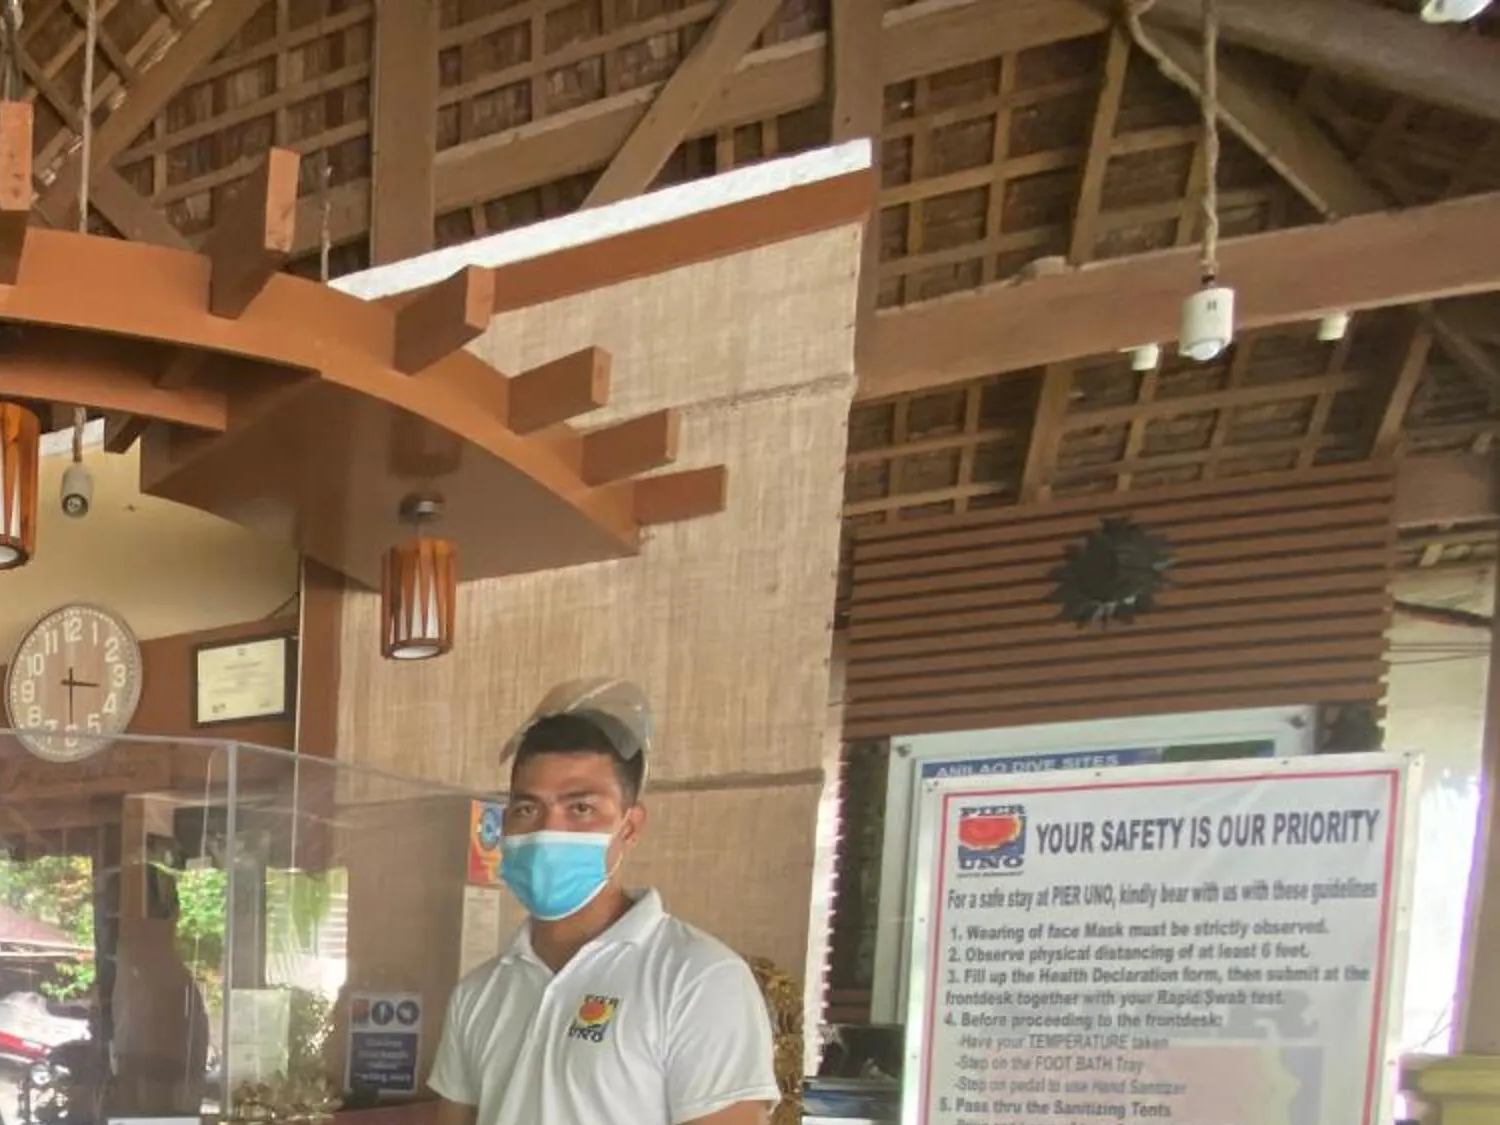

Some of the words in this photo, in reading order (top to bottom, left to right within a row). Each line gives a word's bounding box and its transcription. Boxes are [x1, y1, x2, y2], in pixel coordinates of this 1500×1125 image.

[63, 616, 83, 642] 12
[92, 620, 97, 646] 1
[44, 629, 58, 655] 11
[105, 636, 121, 663] 2
[27, 654, 44, 676] 10
[113, 664, 126, 688] 3
[21, 680, 35, 703] 9
[102, 692, 117, 714] 4
[28, 706, 41, 727] 8
[87, 713, 100, 734] 5
[1064, 755, 1119, 767] SITES
[1036, 823, 1094, 854] YOUR
[1101, 817, 1184, 851] SAFETY
[1190, 816, 1211, 848] IS
[1218, 814, 1265, 847] OUR
[1273, 809, 1380, 845] PRIORITY
[959, 857, 1024, 870] UNO
[948, 890, 966, 908] For
[969, 893, 977, 908] a
[979, 888, 1006, 907] safe
[1009, 888, 1033, 911] stay
[1036, 887, 1049, 906] at
[1052, 886, 1082, 905] PIER
[1084, 885, 1116, 909] UNO,
[1120, 883, 1157, 908] kindly
[1161, 882, 1188, 902] bear
[1192, 881, 1219, 901] with
[1223, 885, 1237, 901] us
[1242, 880, 1269, 900] with
[1273, 879, 1308, 900] these
[1311, 877, 1377, 905] guidelines
[967, 926, 1024, 943] Wearing
[1028, 924, 1043, 939] of
[1048, 925, 1080, 938] face
[1084, 922, 1123, 938] Mask
[1129, 922, 1166, 937] must
[1171, 922, 1189, 936] be
[1194, 919, 1249, 939] strictly
[965, 948, 1024, 961] Observe
[1029, 947, 1091, 964] physical
[1095, 946, 1174, 963] distancing
[1178, 945, 1193, 960] of
[1198, 945, 1215, 959] at
[1219, 944, 1258, 959] least
[964, 969, 986, 982] Fill
[990, 971, 1007, 985] up
[1012, 969, 1035, 982] the
[1040, 969, 1087, 982] Health
[1092, 967, 1178, 982] Declaration
[1228, 967, 1262, 981] then
[1267, 967, 1319, 981] submit
[1324, 967, 1339, 980] at
[1344, 965, 1369, 980] the
[946, 991, 1012, 1005] frontdesk
[1018, 992, 1078, 1008] together
[1082, 992, 1115, 1004] with
[1120, 994, 1153, 1007] your
[1157, 990, 1200, 1006] Rapid
[961, 1012, 1006, 1026] Before
[1012, 1013, 1092, 1029] proceeding
[1098, 1014, 1112, 1026] to
[1118, 1013, 1141, 1027] the
[956, 1097, 989, 1113] Pass
[994, 1098, 1022, 1114] thru
[1026, 1099, 1049, 1114] the
[1054, 1099, 1126, 1119] Sanitizing
[1131, 1102, 1171, 1118] Tents
